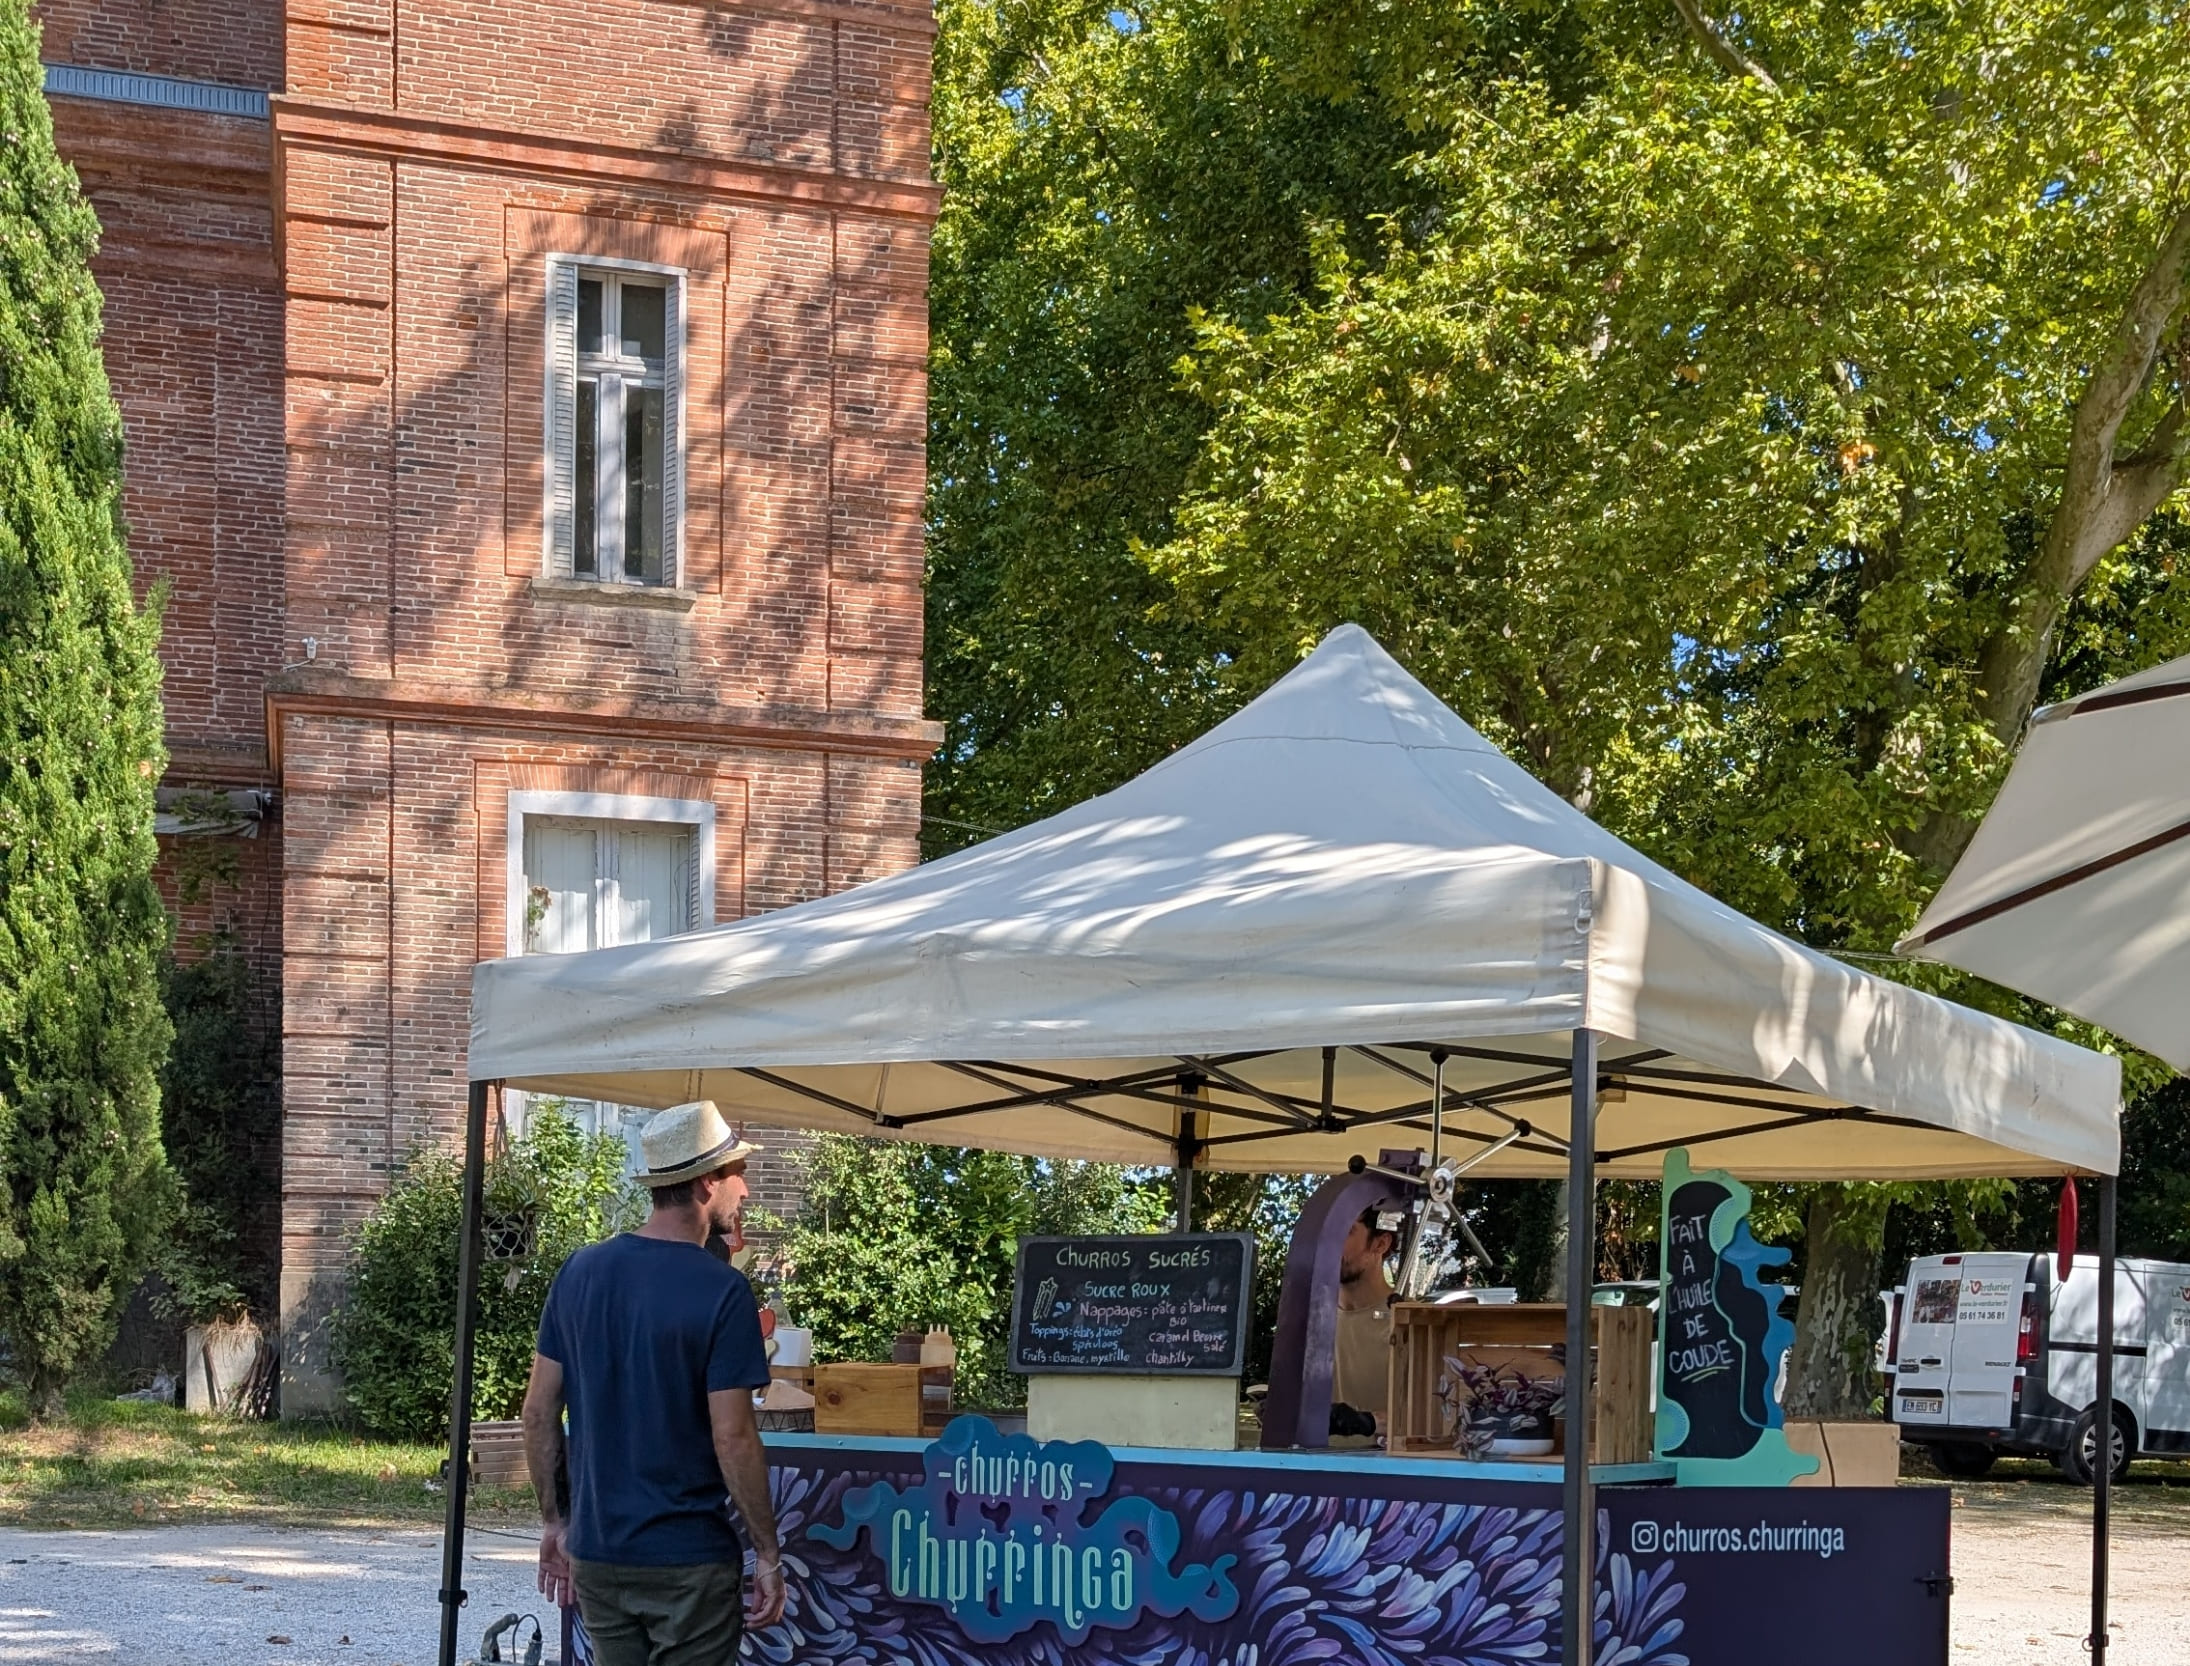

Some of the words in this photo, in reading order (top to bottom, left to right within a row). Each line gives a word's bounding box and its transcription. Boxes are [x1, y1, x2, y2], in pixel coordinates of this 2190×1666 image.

[1148, 1245, 1211, 1269] SUCRÉS
[1682, 1250, 1696, 1276] À
[1152, 1300, 1176, 1320] pâte
[1977, 1311, 1987, 1320] 74
[1683, 1313, 1710, 1340] DE
[1668, 1339, 1736, 1374] COUDE
[1663, 1520, 1845, 1559] churros.churringa
